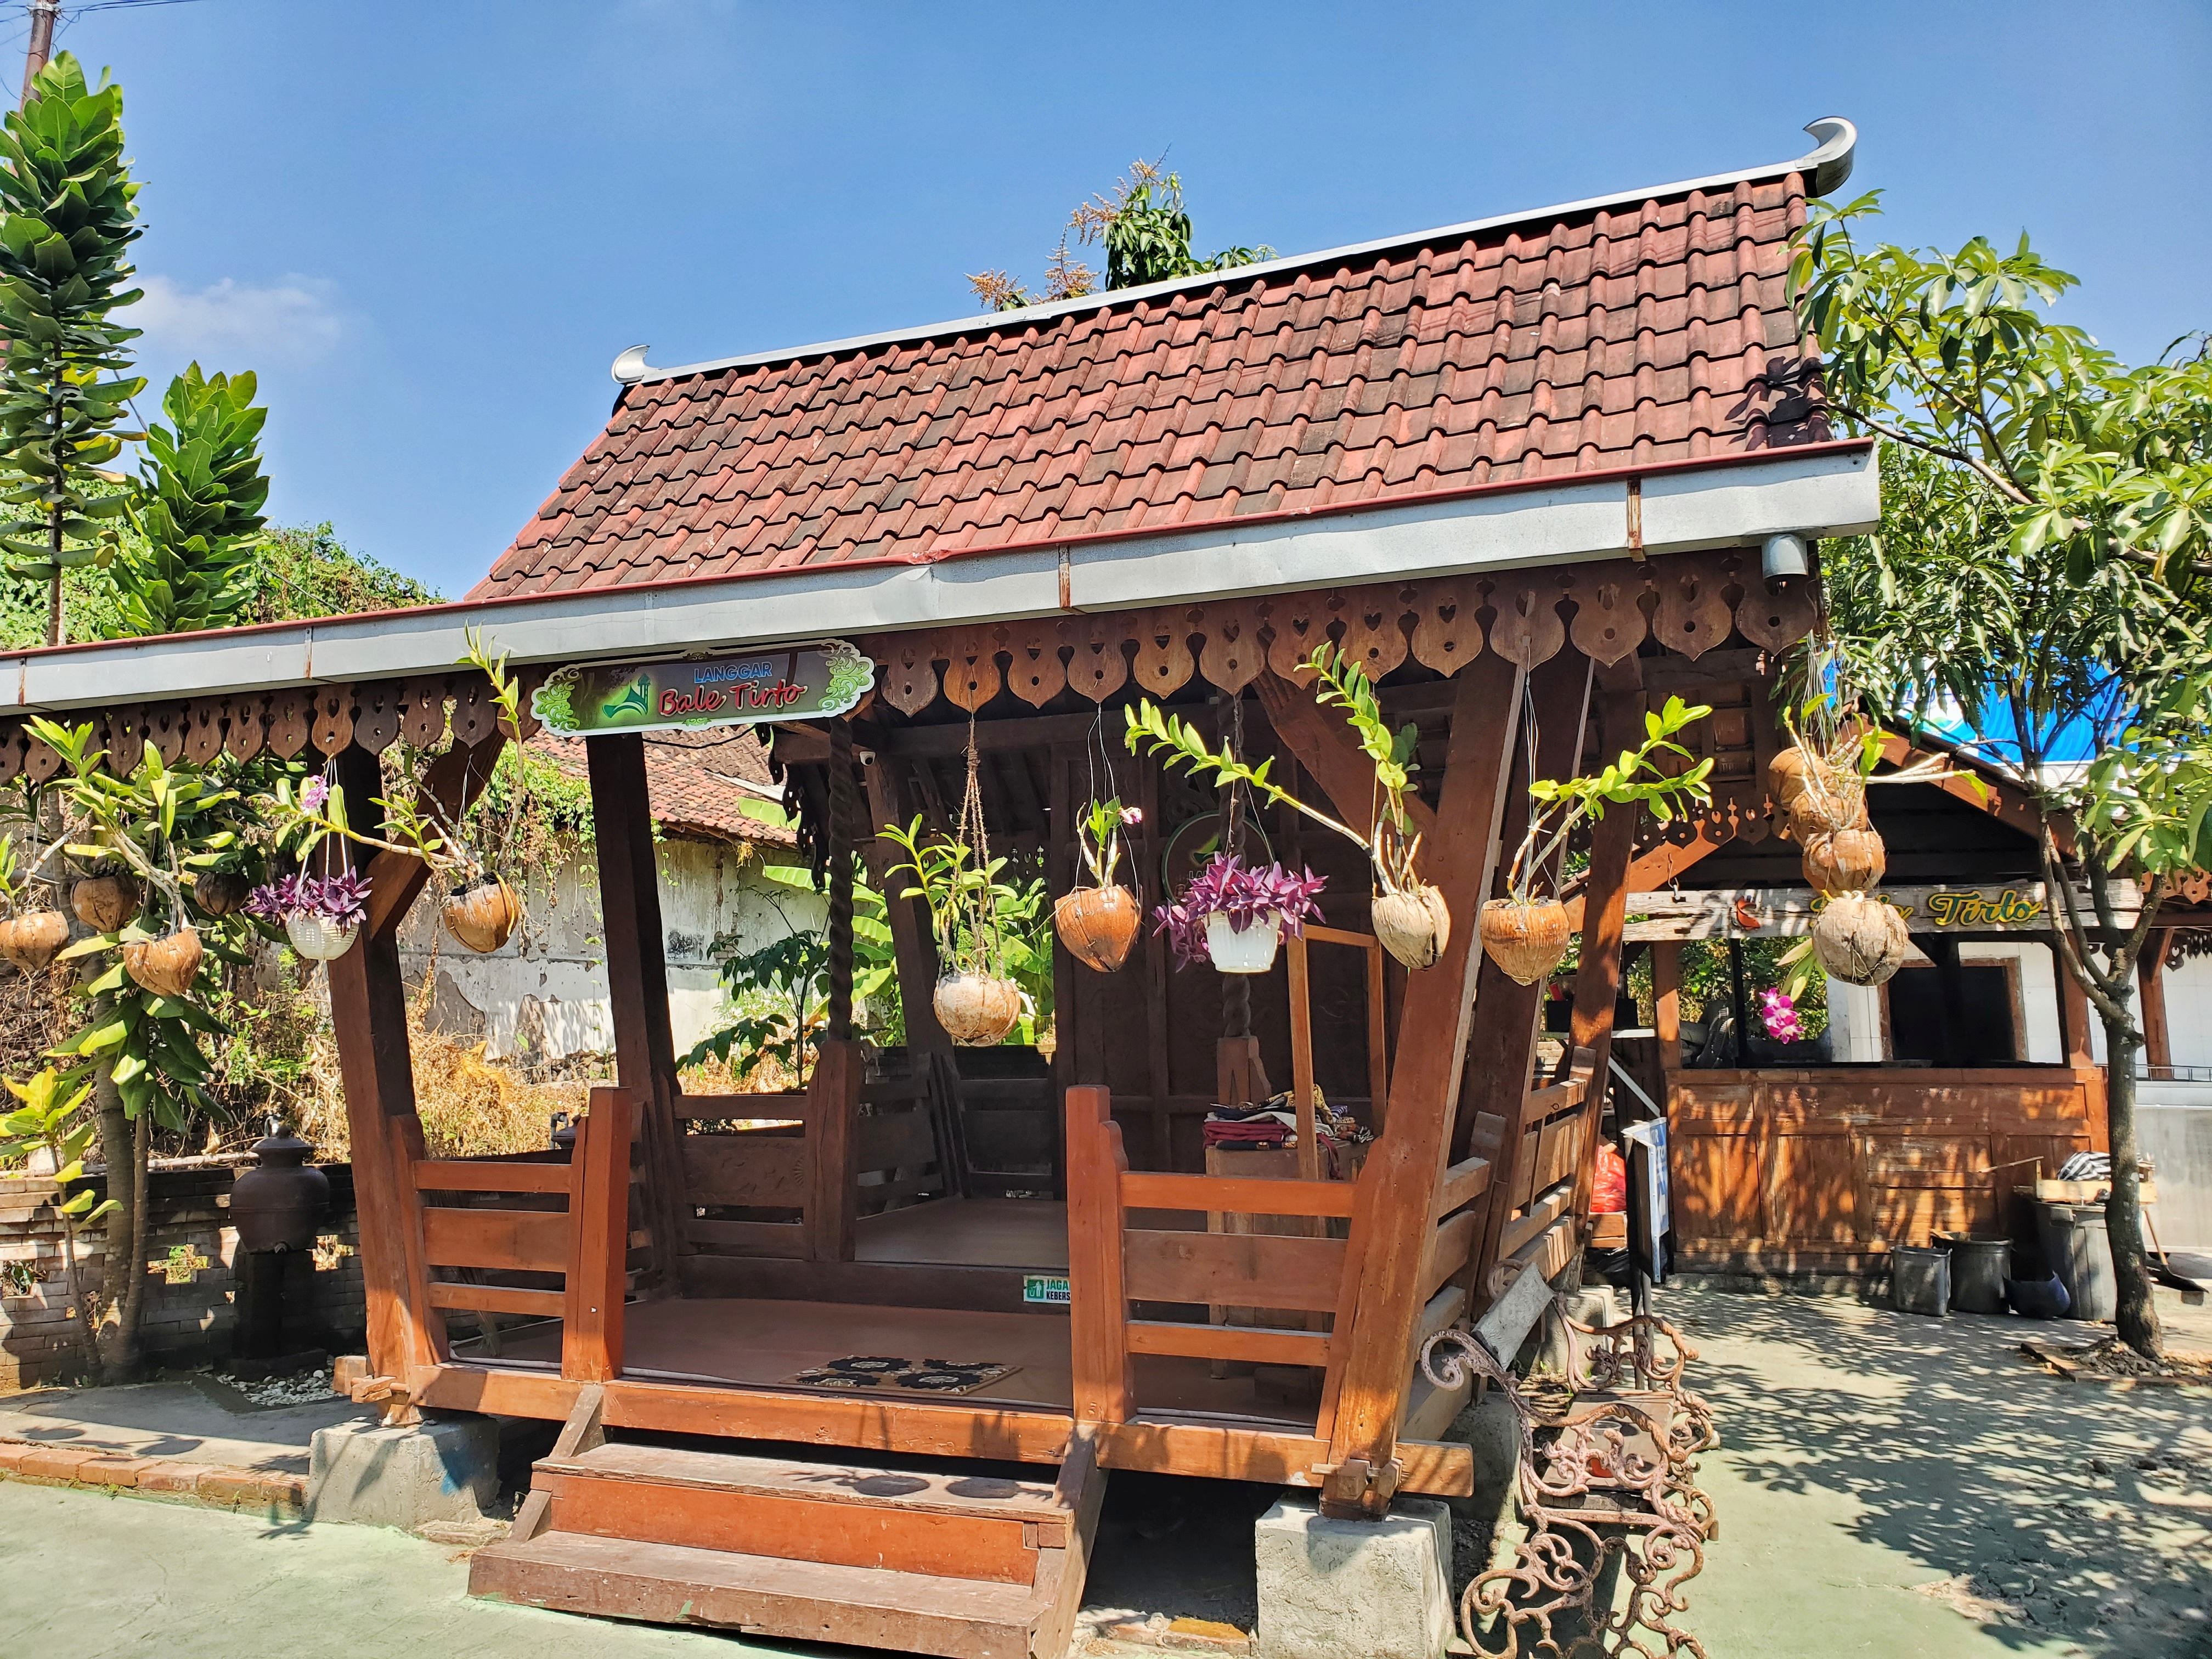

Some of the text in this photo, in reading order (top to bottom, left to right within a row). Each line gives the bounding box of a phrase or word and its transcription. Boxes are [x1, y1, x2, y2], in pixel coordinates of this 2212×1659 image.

[694, 662, 772, 684] LANGGAR
[659, 679, 808, 716] Bale Tirto
[1929, 890, 2043, 926] Tirto
[1046, 1279, 1069, 1290] JAGA
